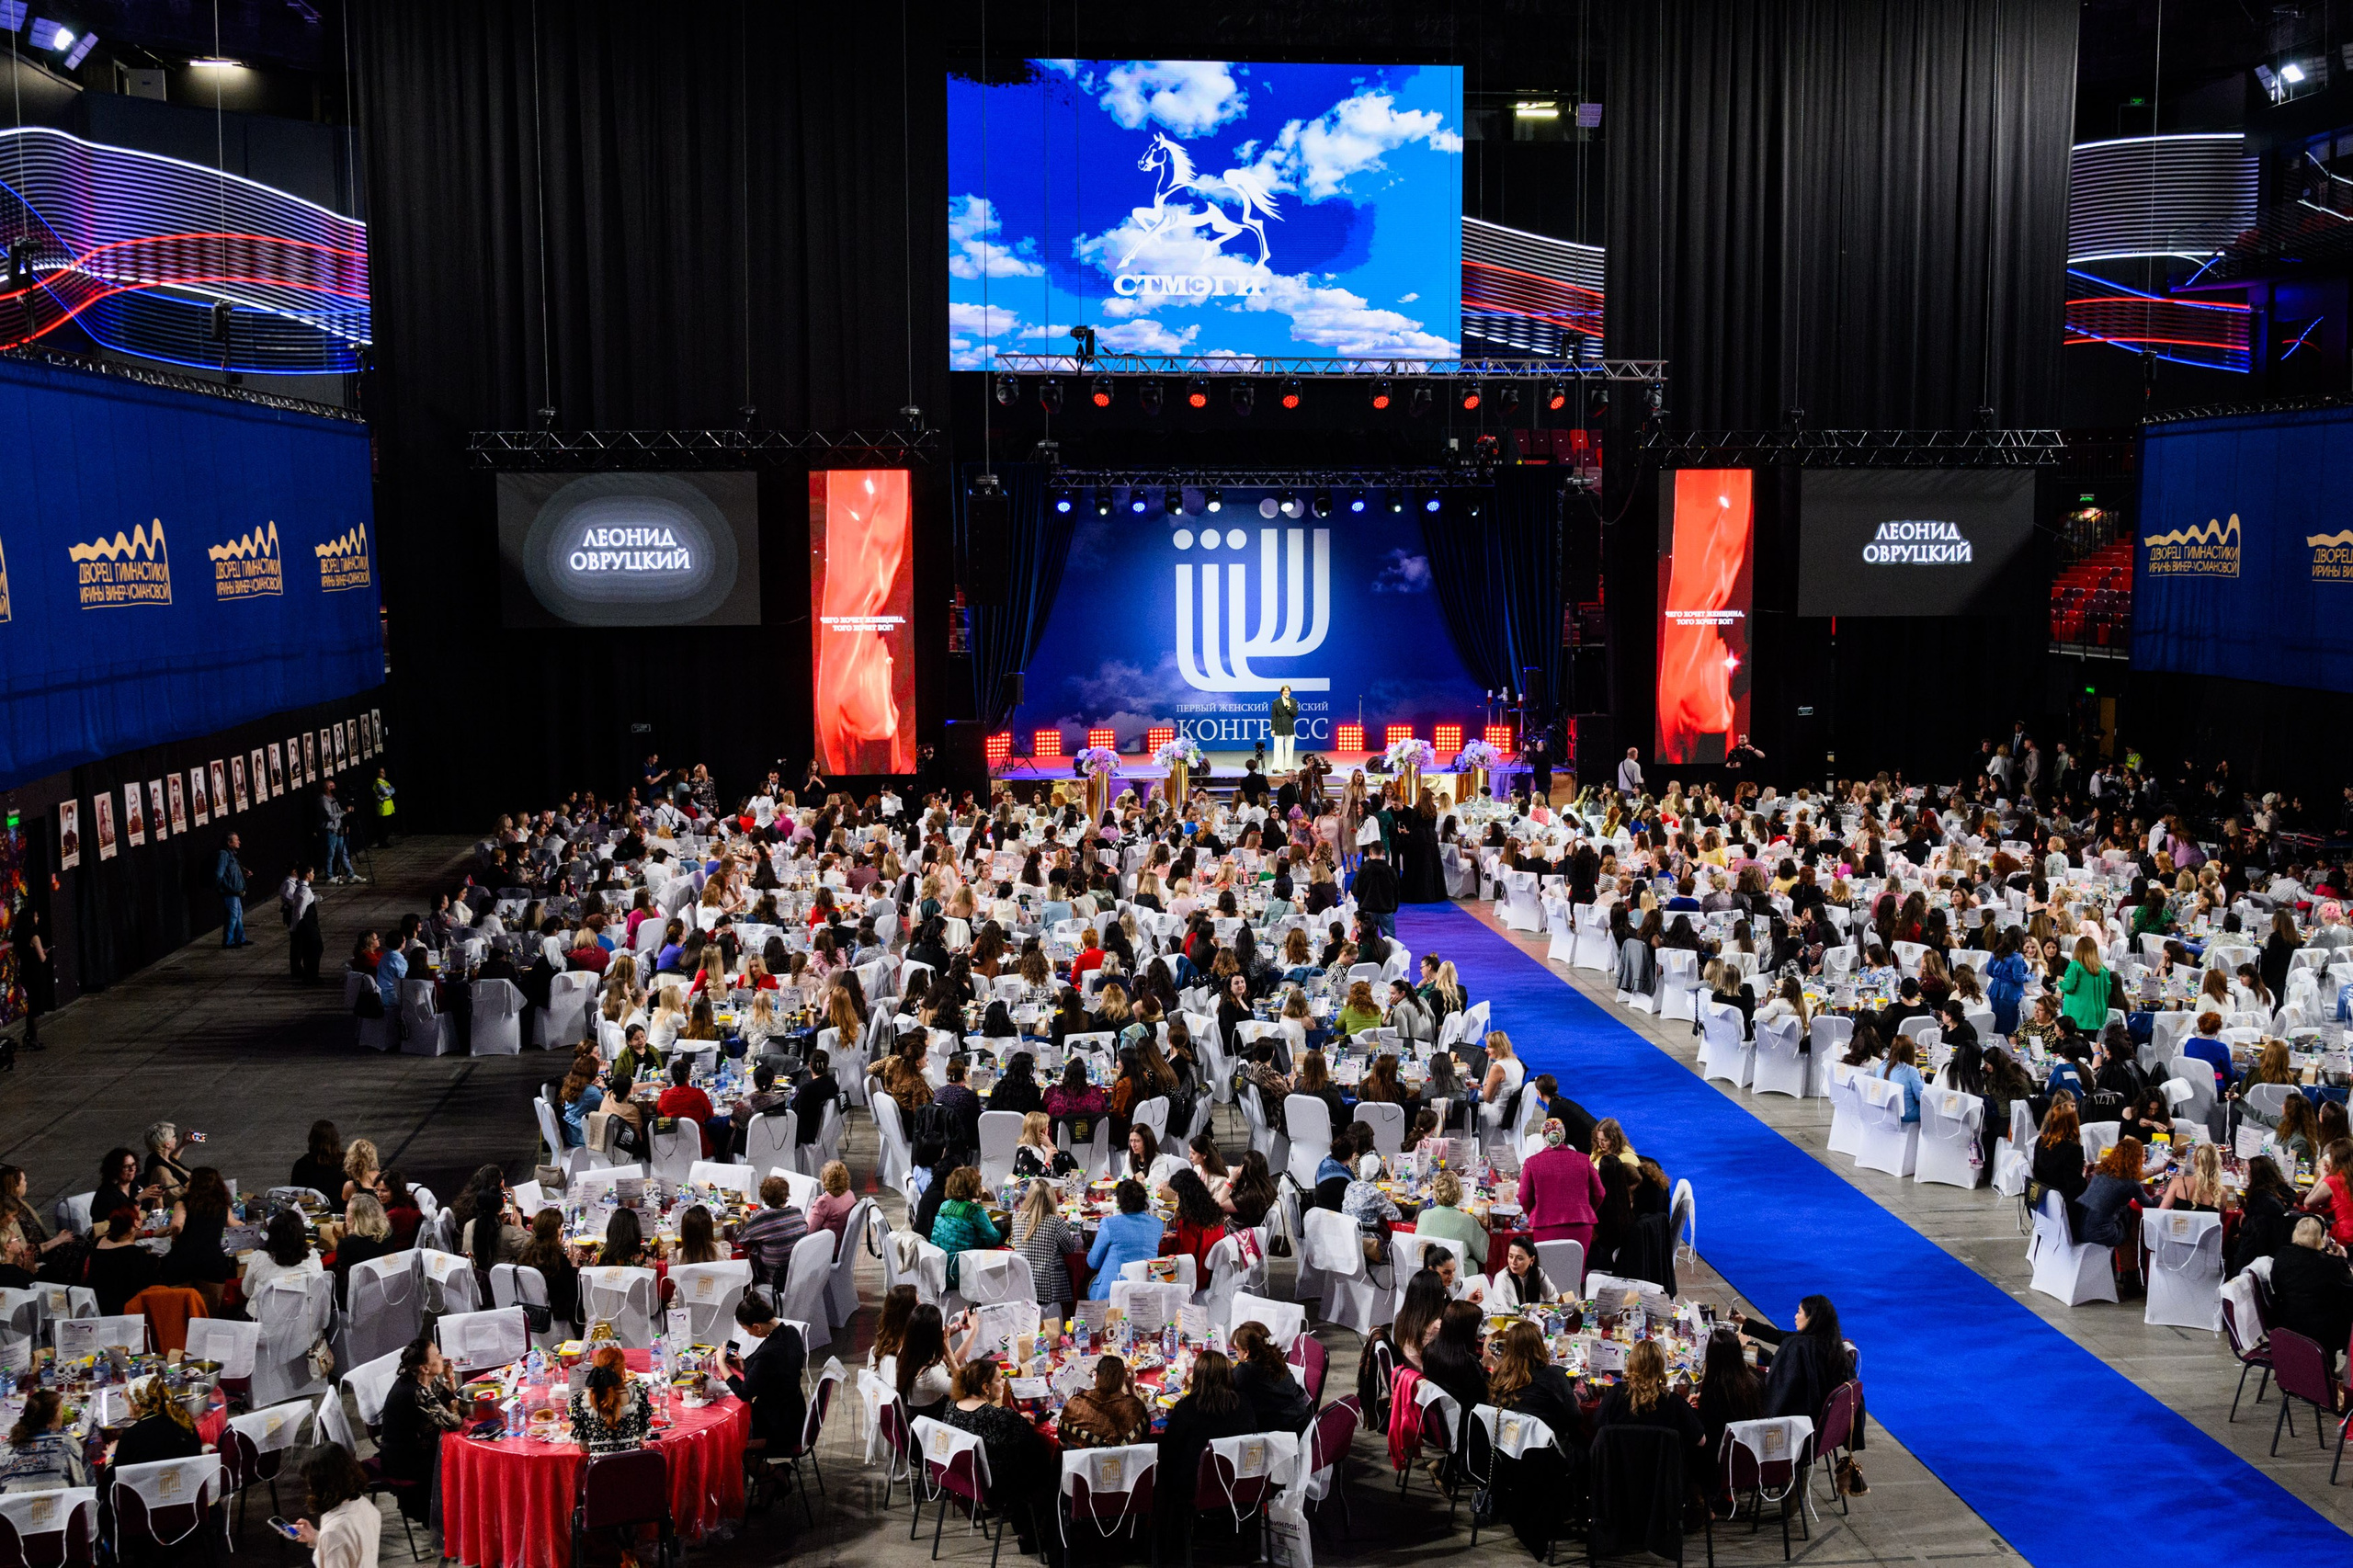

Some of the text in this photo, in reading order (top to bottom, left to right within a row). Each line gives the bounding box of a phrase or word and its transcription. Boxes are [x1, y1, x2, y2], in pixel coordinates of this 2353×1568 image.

[1113, 274, 1264, 296] СТМЭГИ
[583, 528, 676, 547] ЛЕОНИД
[1875, 522, 1961, 540] ЛЕОНИД
[570, 548, 690, 571] ОВРУЦКИЙ
[1863, 541, 1972, 562] ОВРУЦКИЙ
[2150, 545, 2238, 561] ДВОРЕЦ ГИМНАСТИКИ
[79, 562, 168, 584] ДВОРЕЦ ГИМНАСТИКИ
[215, 558, 280, 579] ДВОРЕЦ ГИМНАСТИКИ
[2172, 561, 2237, 574] ВИНЕР-УСМАНОВОЙ
[2312, 565, 2341, 577] ИРИНЫ
[80, 583, 170, 603] ИРИНЫ ВИНЕР-УСМАНОВОЙ
[216, 580, 234, 596] ИРИНЫ
[1176, 702, 1217, 712] ПЕРВЫЙ
[1219, 701, 1269, 712] ЖЕНСКИЙ
[1176, 718, 1329, 741] КОНГРСС
